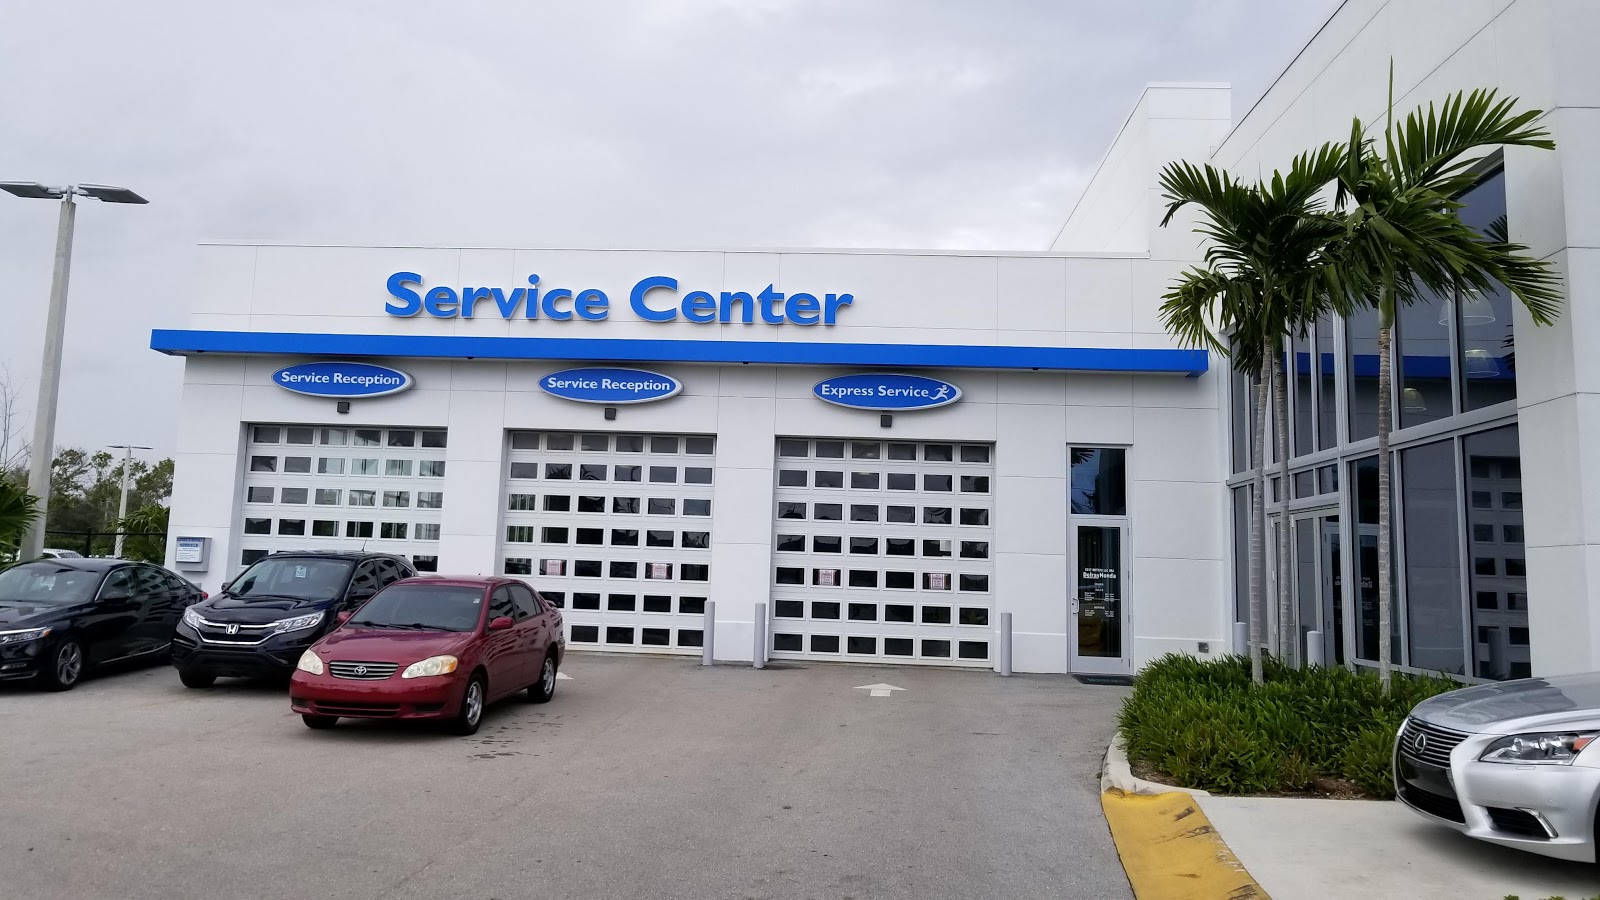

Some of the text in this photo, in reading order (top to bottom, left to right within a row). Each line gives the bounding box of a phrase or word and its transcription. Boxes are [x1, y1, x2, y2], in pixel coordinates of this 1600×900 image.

[385, 271, 854, 327] Service Center
[281, 371, 400, 387] Service Reception
[547, 377, 670, 393] Service Reception
[821, 384, 929, 398] Express Service
